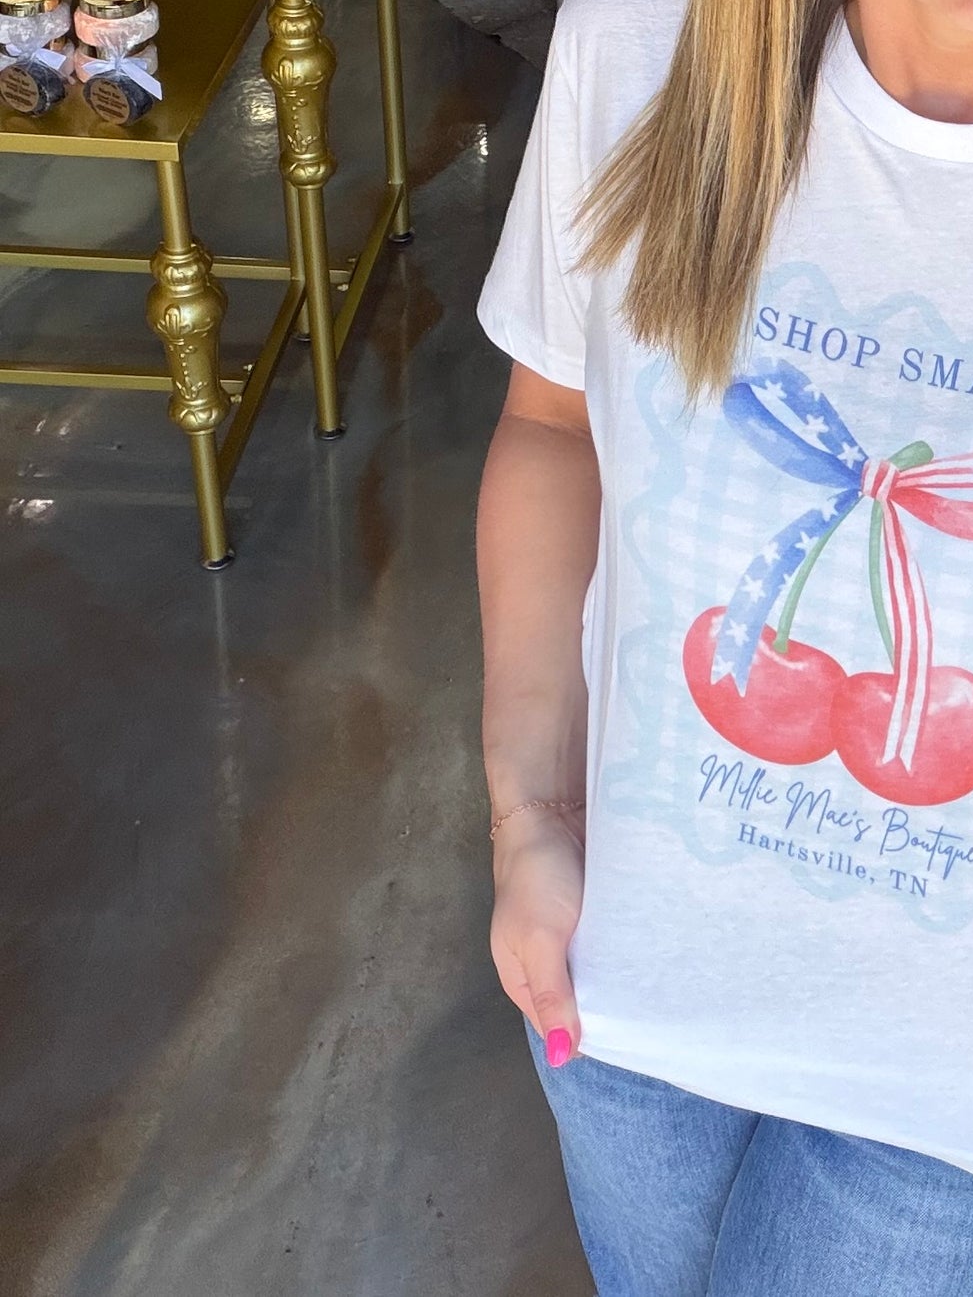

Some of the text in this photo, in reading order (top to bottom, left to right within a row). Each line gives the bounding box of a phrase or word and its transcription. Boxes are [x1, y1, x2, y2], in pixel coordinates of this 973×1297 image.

[754, 306, 881, 369] SHOP
[699, 753, 778, 811] Millie
[785, 780, 872, 844] Mae's
[737, 822, 929, 898] Hartsville, TN
